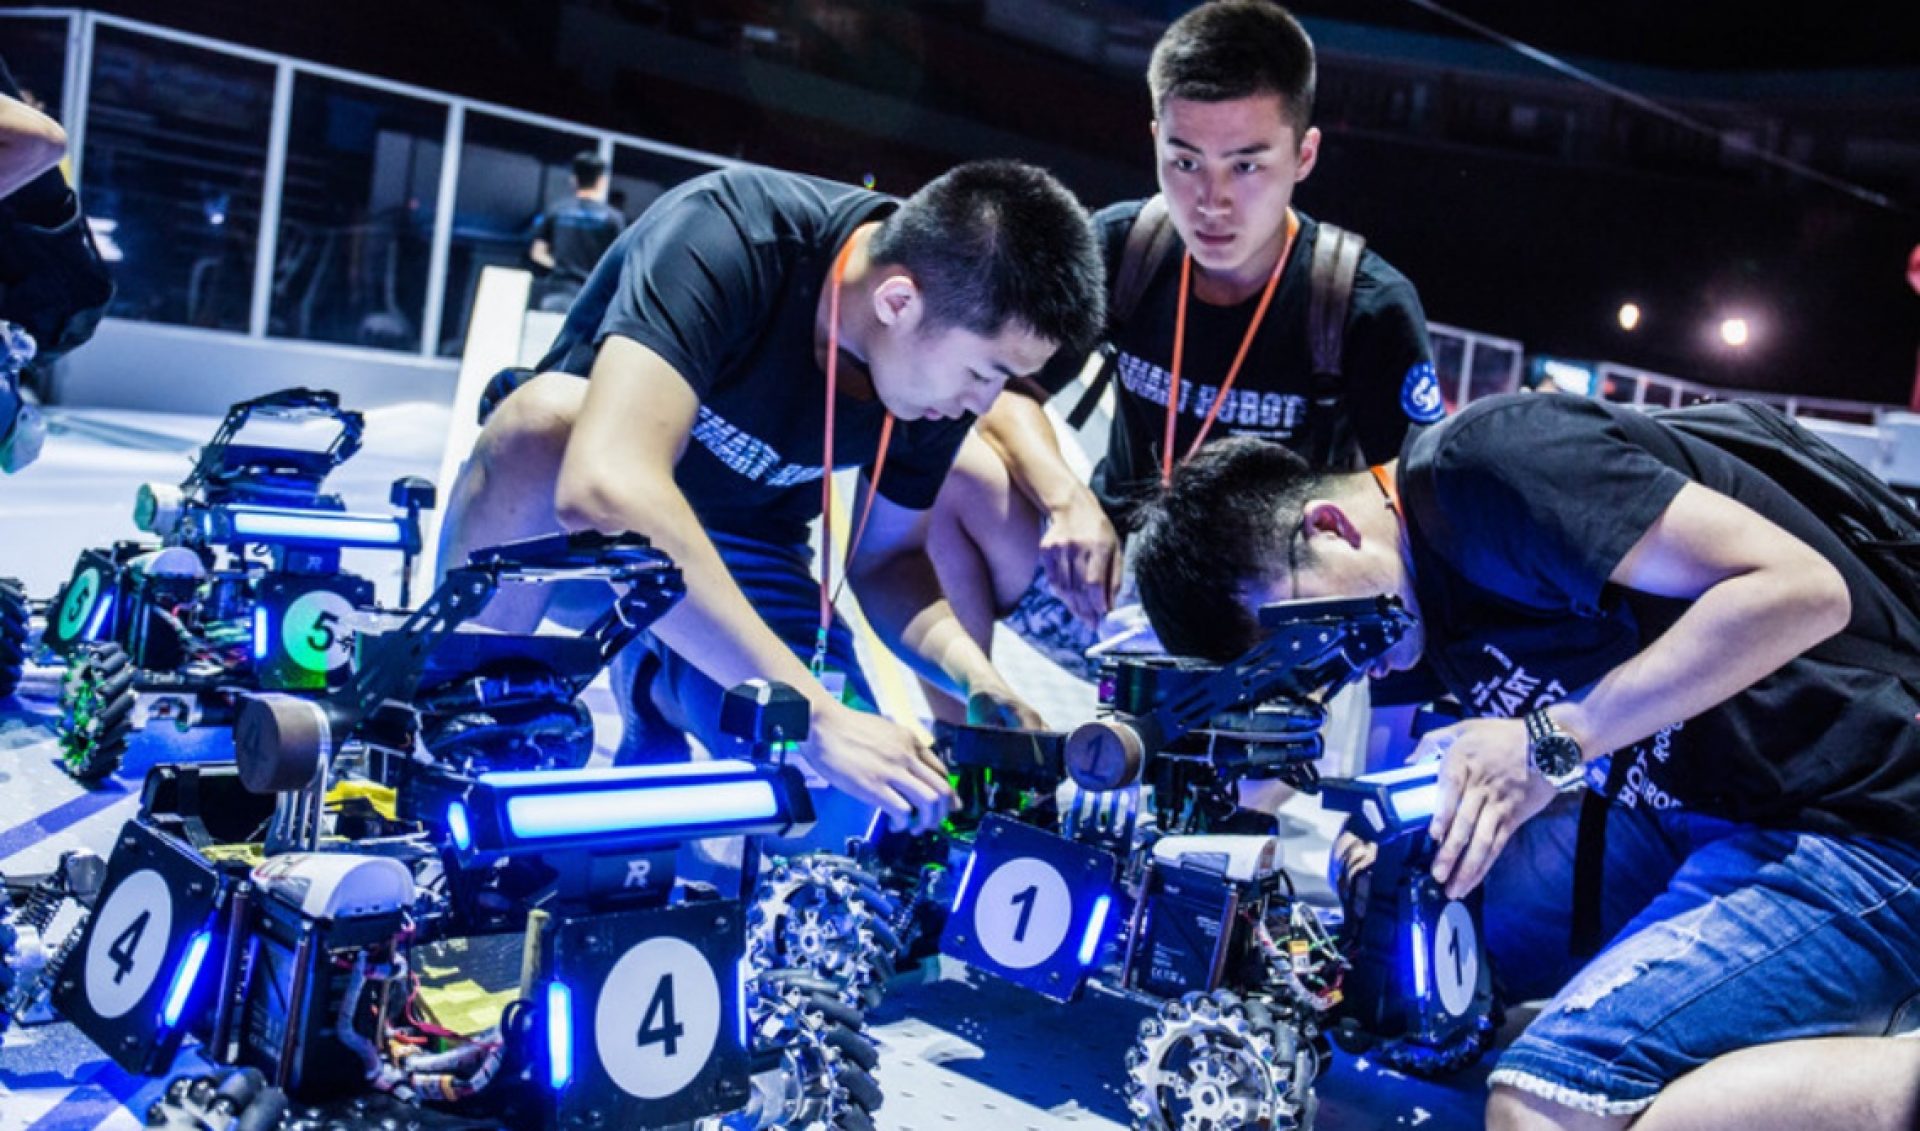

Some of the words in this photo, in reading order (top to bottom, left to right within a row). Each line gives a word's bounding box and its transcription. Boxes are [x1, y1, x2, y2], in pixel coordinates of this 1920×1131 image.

[306, 610, 338, 652] 5
[1080, 733, 1108, 783] 1
[1009, 884, 1037, 942] 1
[108, 909, 151, 985] 4
[1448, 926, 1463, 987] 1
[636, 973, 684, 1058] 4
